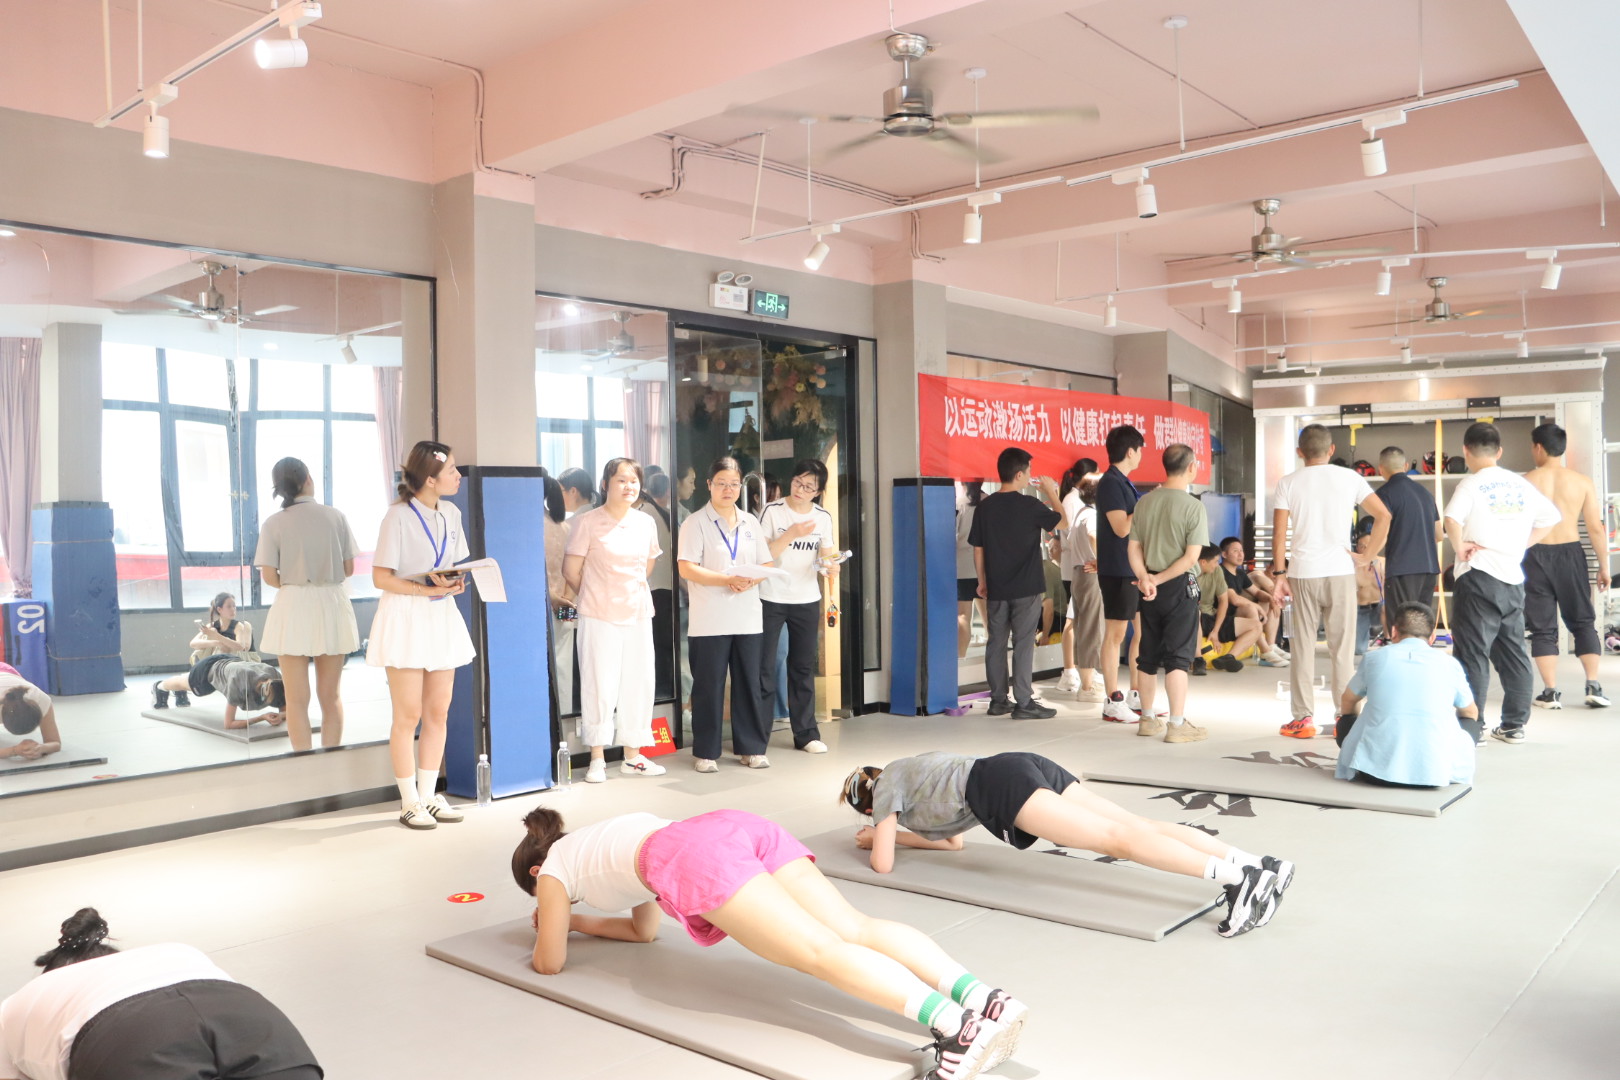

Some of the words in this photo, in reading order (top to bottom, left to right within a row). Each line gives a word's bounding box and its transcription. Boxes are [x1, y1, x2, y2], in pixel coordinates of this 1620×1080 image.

[944, 395, 1051, 443] 以运动激扬活力
[454, 893, 478, 903] 2
